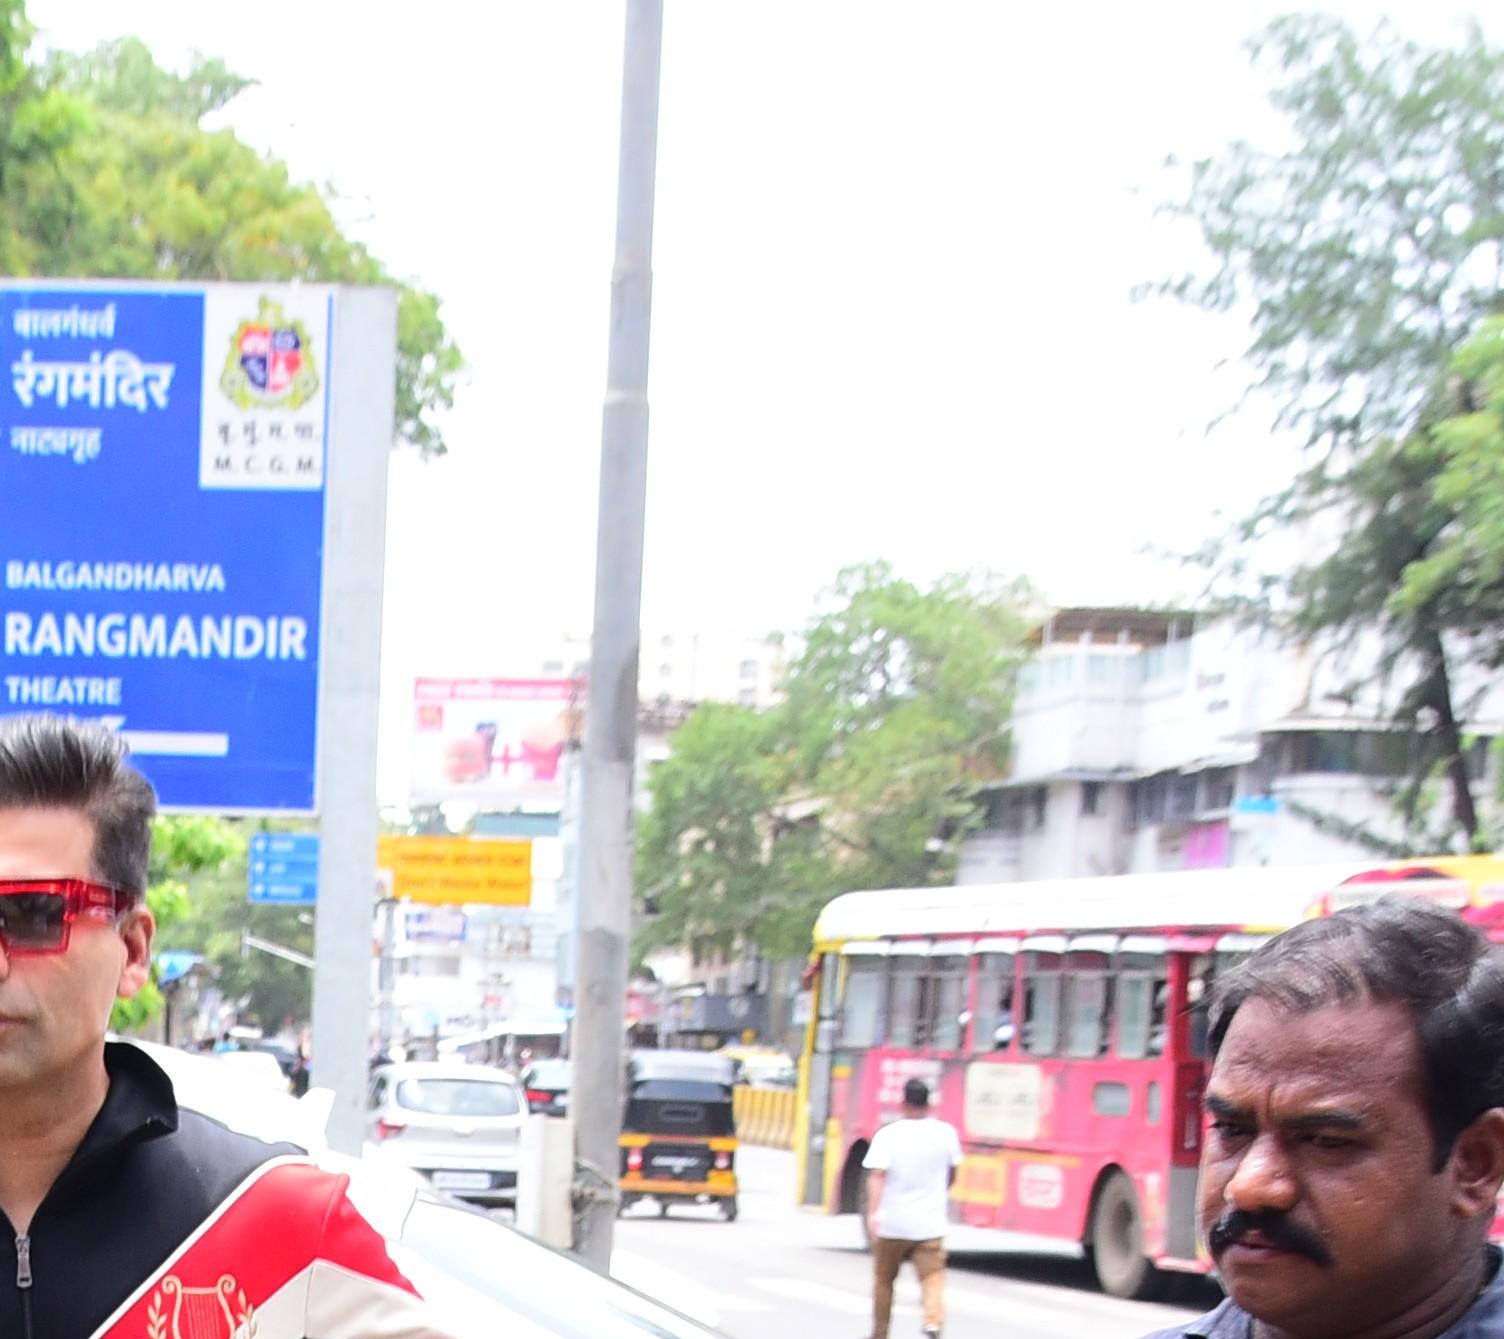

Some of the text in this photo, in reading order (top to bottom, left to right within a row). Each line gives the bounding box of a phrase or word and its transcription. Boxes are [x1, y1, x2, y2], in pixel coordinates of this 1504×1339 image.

[10, 348, 176, 413] रंगमंदिर
[6, 560, 226, 592] BALGANDHARVA
[5, 611, 308, 661] RANGMANDIR
[5, 675, 122, 705] THEATRE
